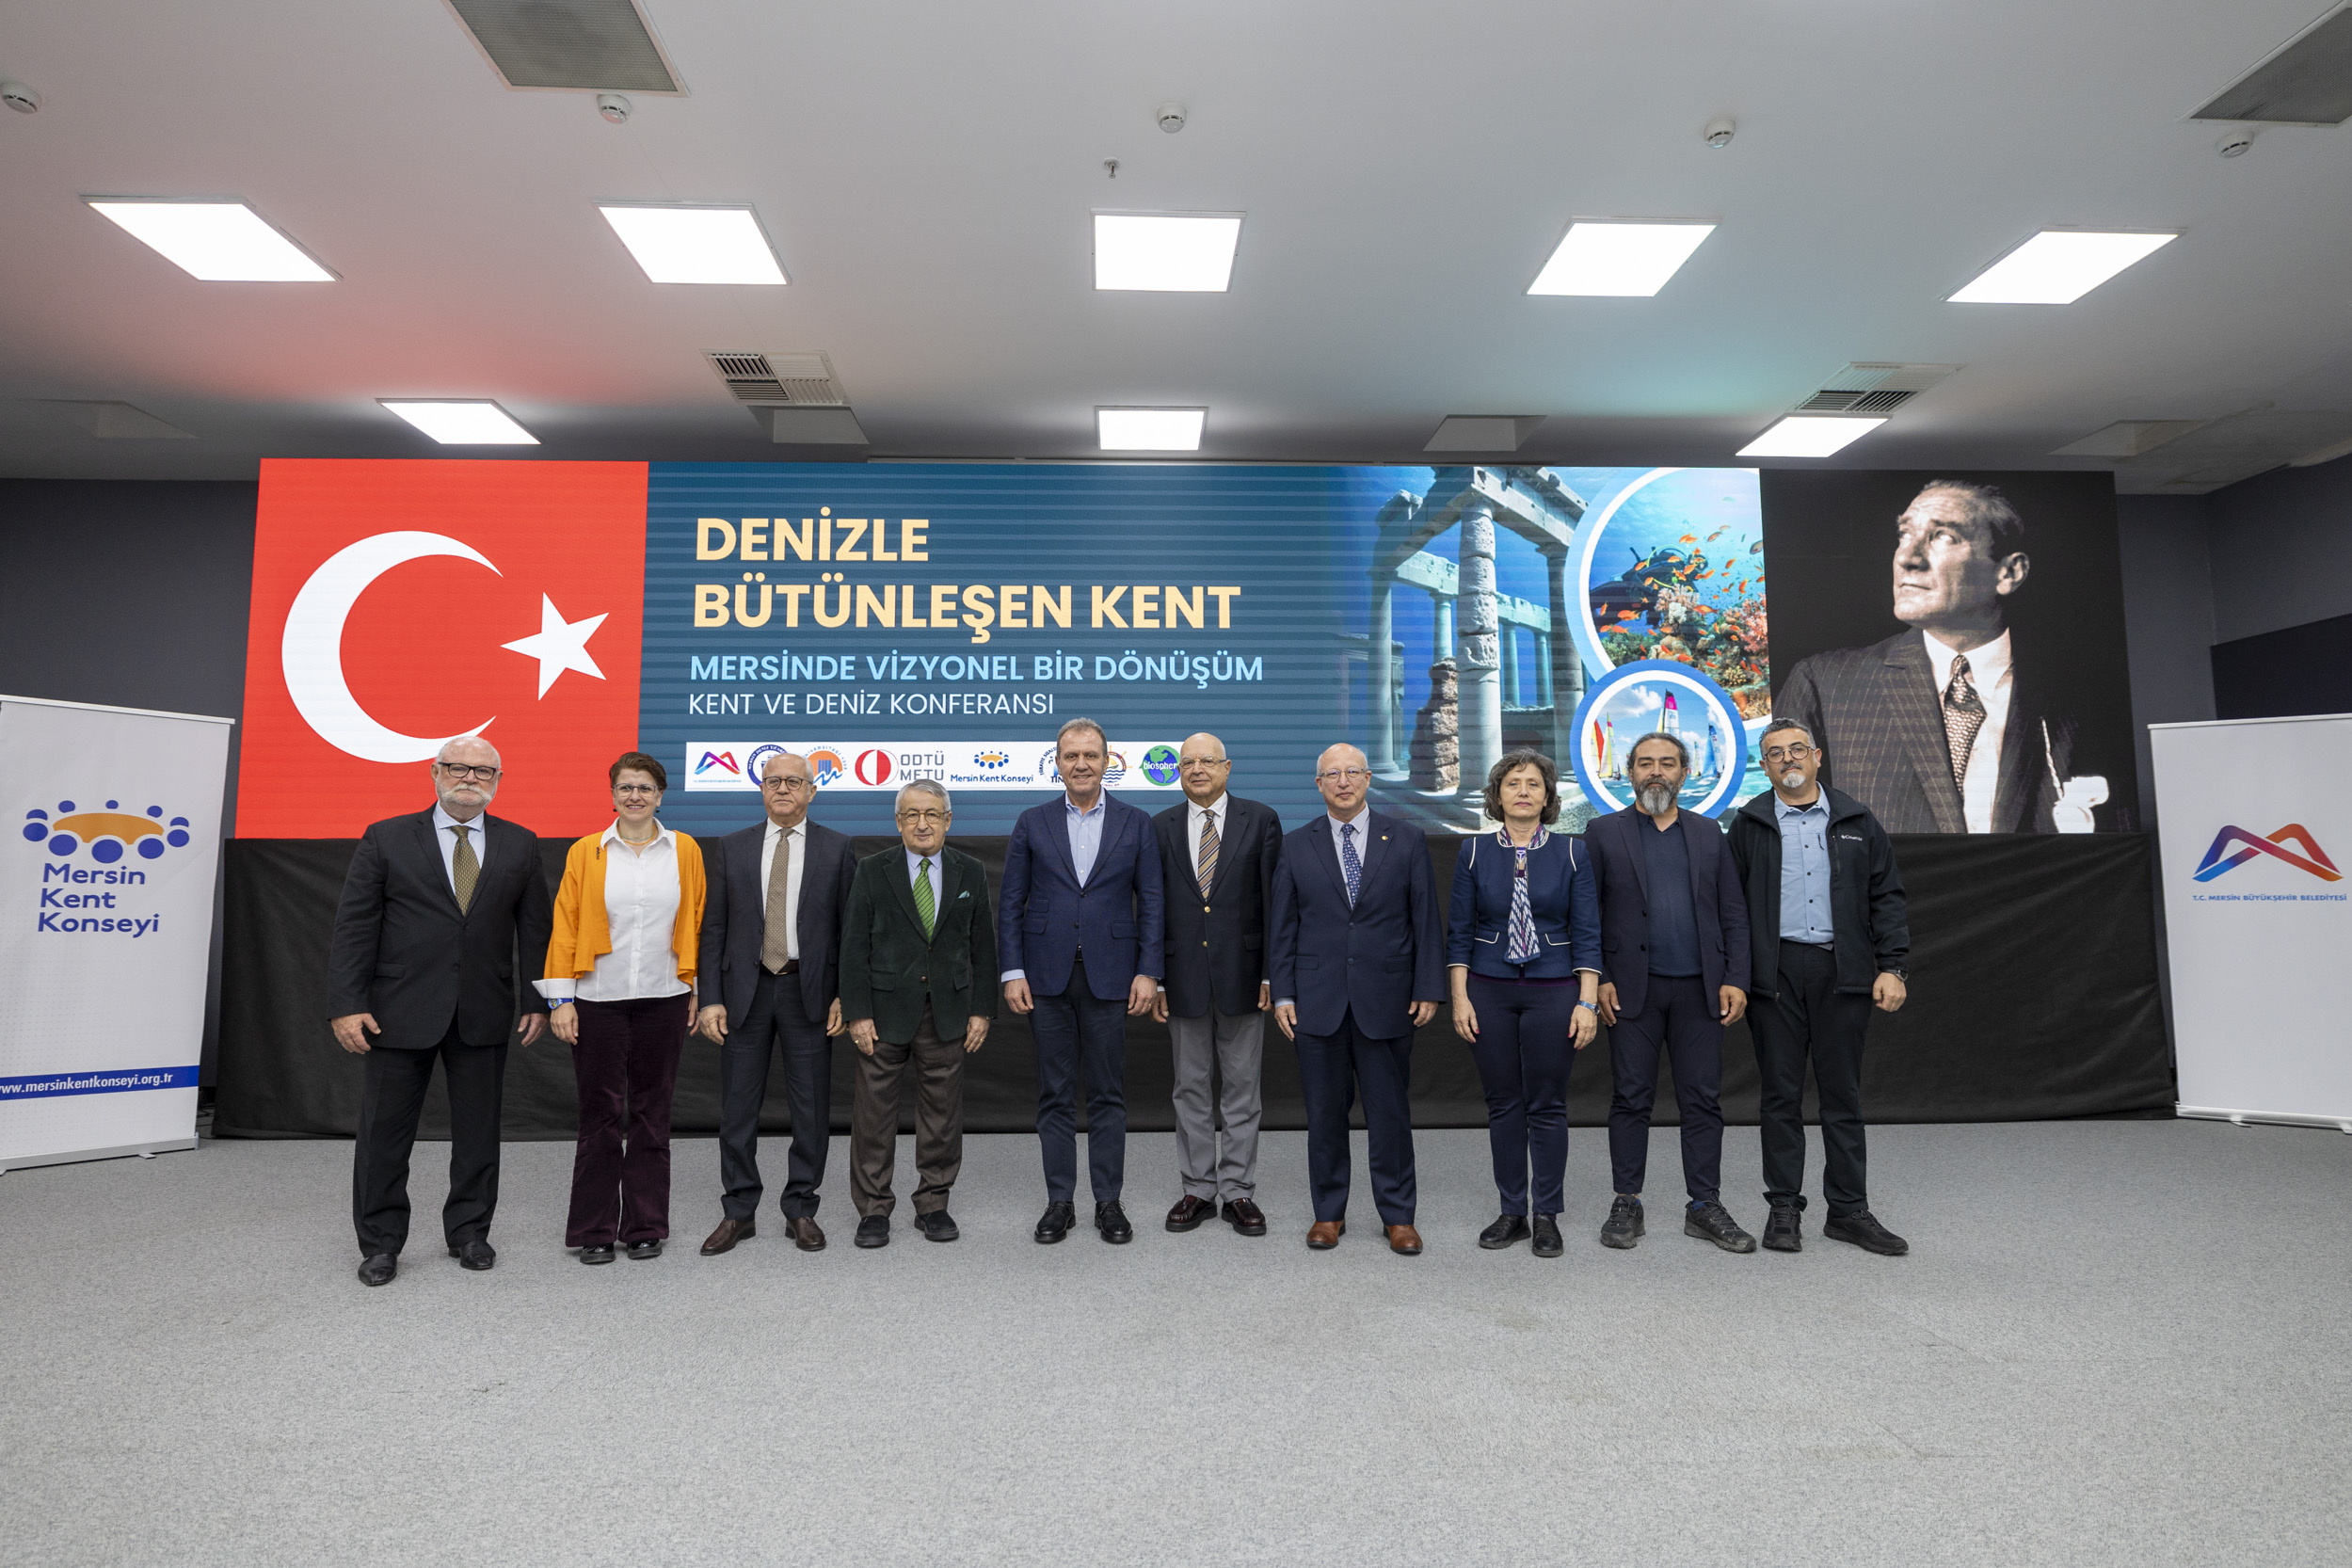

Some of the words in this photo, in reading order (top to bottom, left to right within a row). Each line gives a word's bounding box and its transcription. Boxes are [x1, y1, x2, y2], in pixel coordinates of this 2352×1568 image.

[696, 506, 930, 562] DENİZLE
[694, 572, 1072, 644] BÜTÜNLEŞEN
[1091, 585, 1241, 629] KENT
[690, 649, 856, 680] MERSİNDE
[866, 649, 1024, 680] VİZYONEL
[1034, 649, 1083, 680] BİR
[1095, 649, 1263, 689] DÖNÜŞÜM
[689, 694, 755, 715] KENT
[763, 694, 795, 715] VE
[806, 689, 881, 715] DENİZ
[890, 693, 1054, 715] KONFERANSI
[900, 750, 945, 766] ODTÜ
[1143, 761, 1178, 771] biospher
[900, 769, 945, 781] METU
[950, 775, 979, 783] Mersin
[979, 775, 1000, 783] Kent
[1000, 775, 1034, 785] Konseyi
[42, 862, 146, 885] Mersin
[40, 888, 117, 909] Kent
[2243, 893, 2298, 903] BÜYÜKŞEHİR
[2300, 893, 2347, 902] BELEDİYESİ
[38, 911, 160, 938] Konseyi
[0, 1073, 173, 1094] ww.mersinkentkonseyi.org.tr
